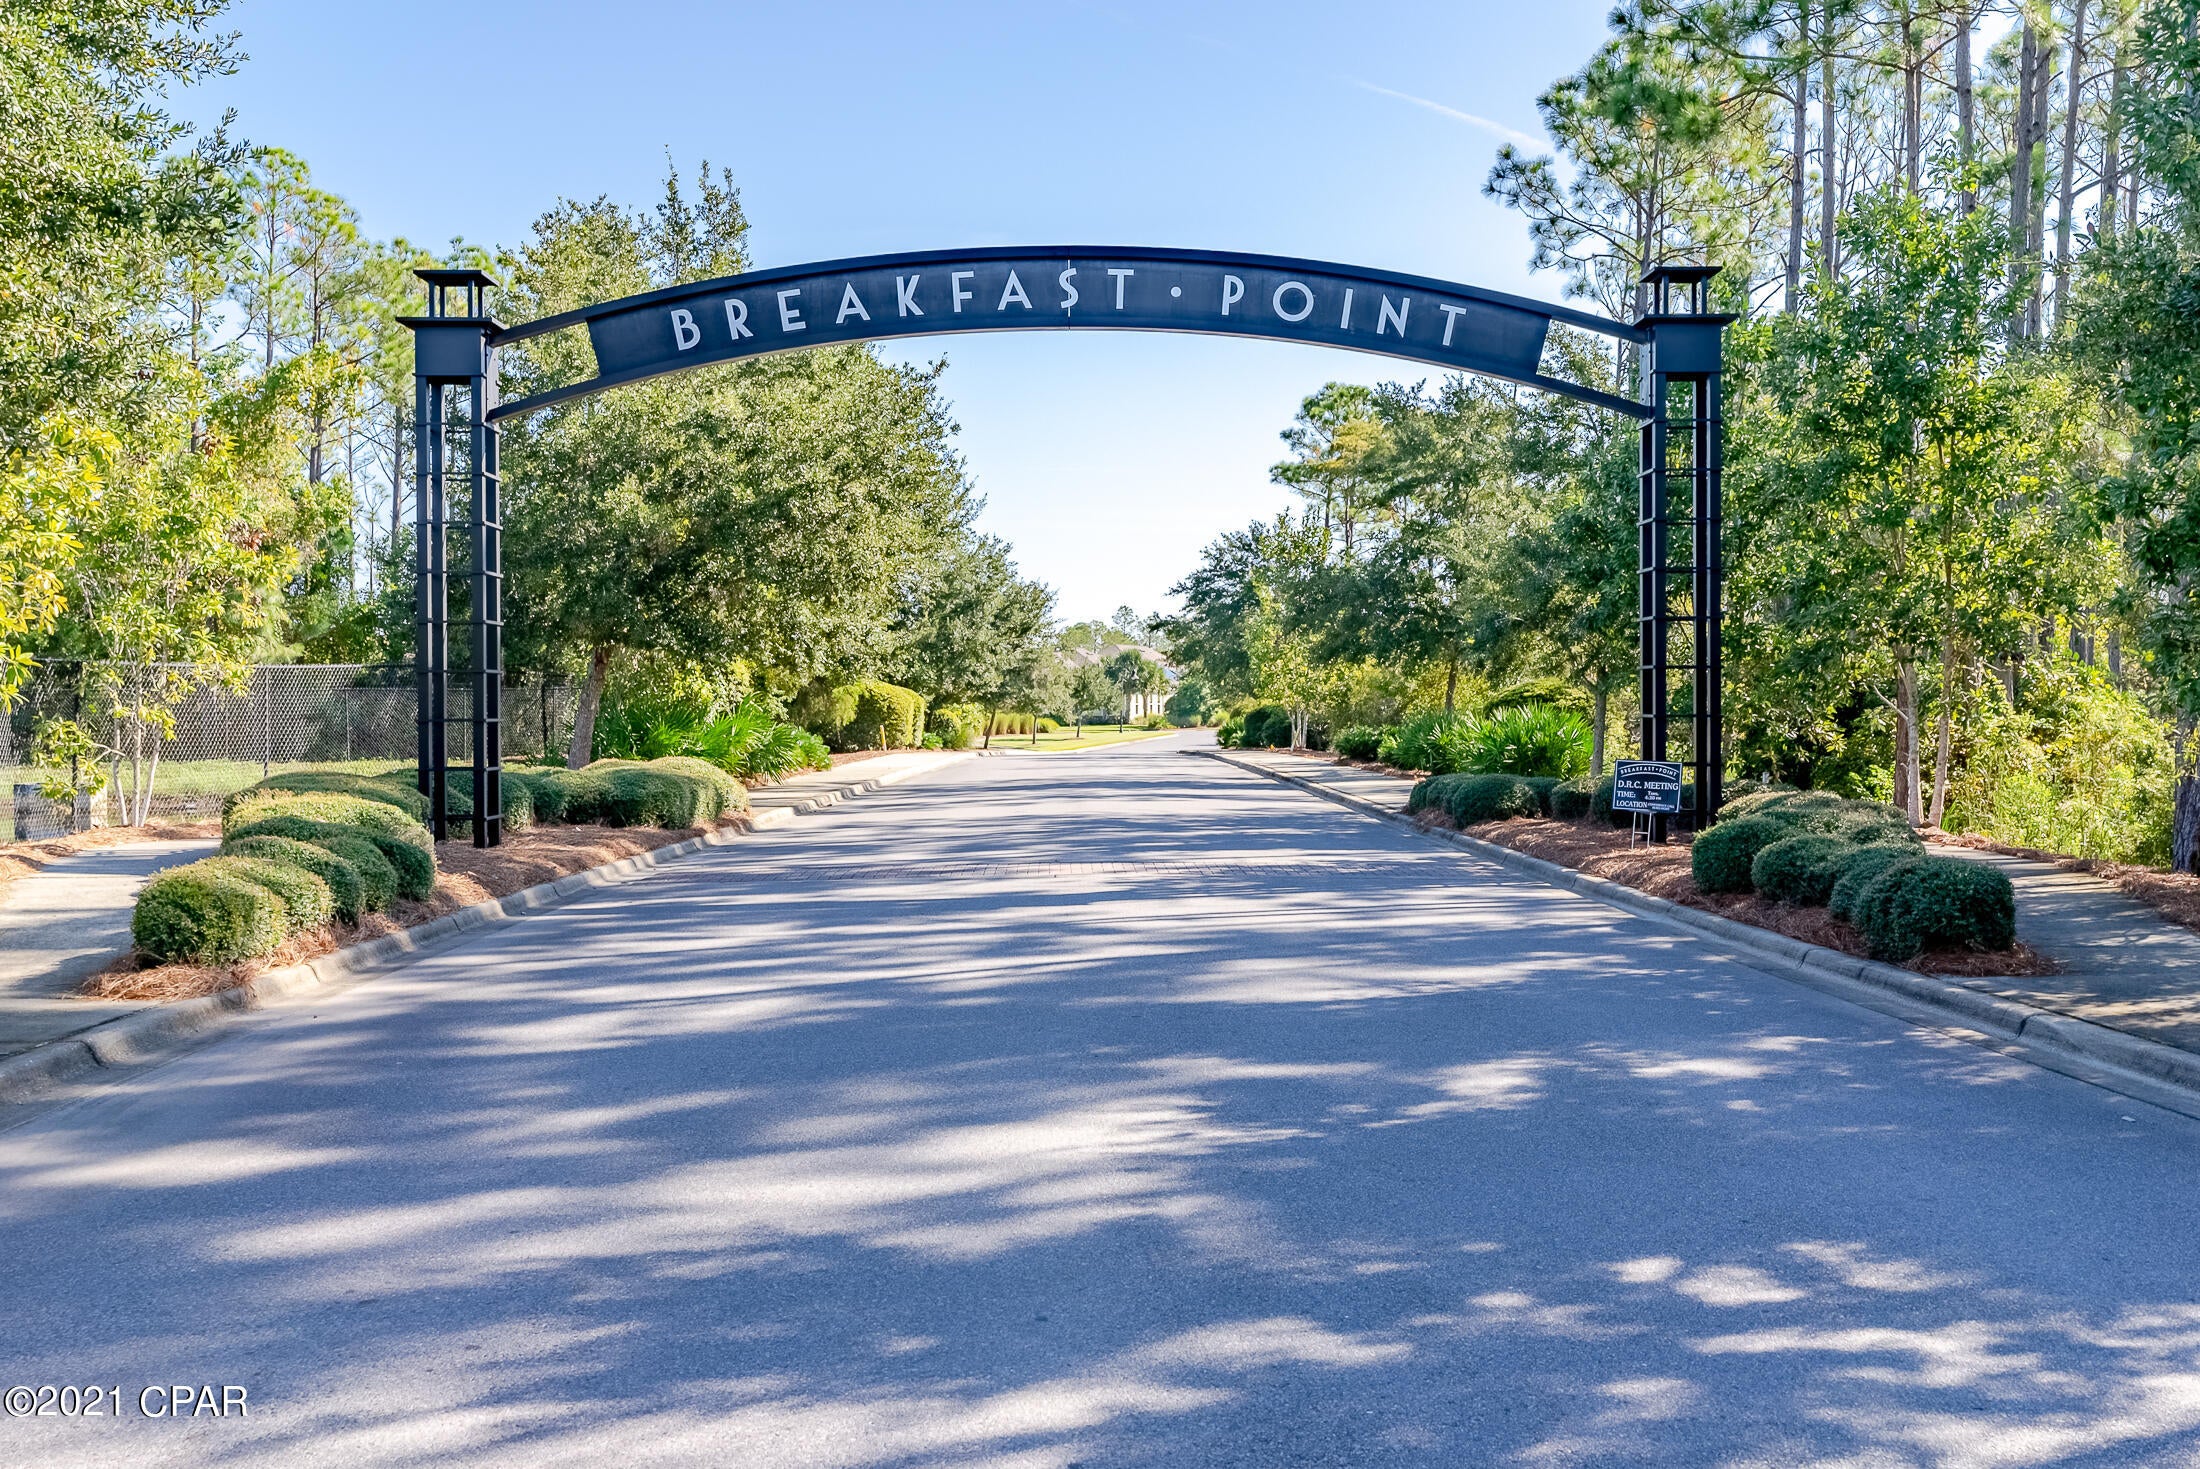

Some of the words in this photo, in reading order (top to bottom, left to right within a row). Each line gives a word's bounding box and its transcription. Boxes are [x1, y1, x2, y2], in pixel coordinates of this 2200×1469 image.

[670, 267, 1134, 352] BREAKFAST
[1220, 273, 1468, 348] POINT
[1620, 766, 1655, 775] BREAKFAST
[1658, 767, 1677, 777] POINT
[1617, 780, 1642, 789] D.R.C.
[1644, 781, 1679, 790] MEETING
[1616, 790, 1636, 798] TIME:
[1616, 800, 1648, 808] LOCATION
